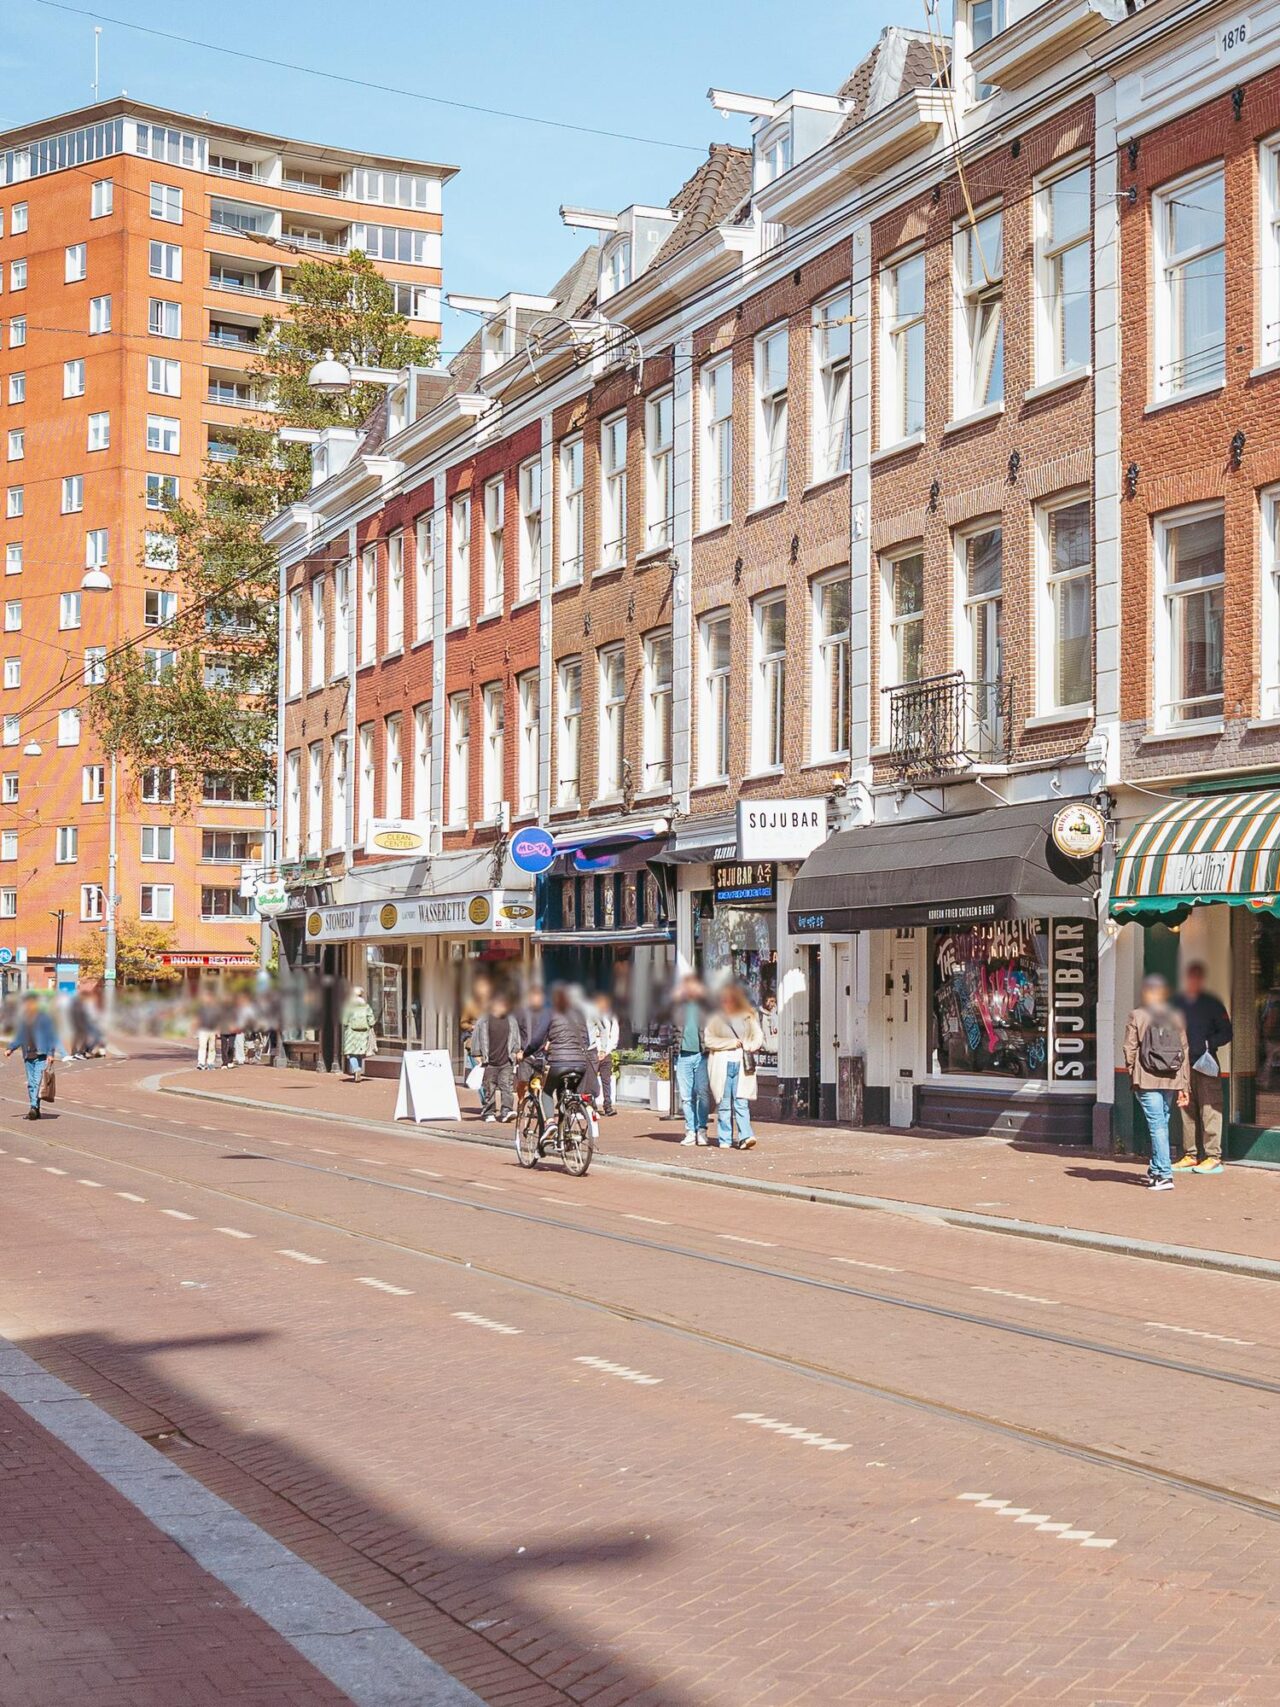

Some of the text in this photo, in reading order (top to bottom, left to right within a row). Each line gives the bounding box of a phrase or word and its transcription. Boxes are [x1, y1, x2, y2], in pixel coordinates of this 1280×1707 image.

[1221, 25, 1246, 52] 1876
[1180, 854, 1227, 892] Bellini
[418, 901, 467, 924] WASSERETTE
[945, 908, 958, 918] FRIED
[170, 956, 256, 965] INDIAN RESTAURA
